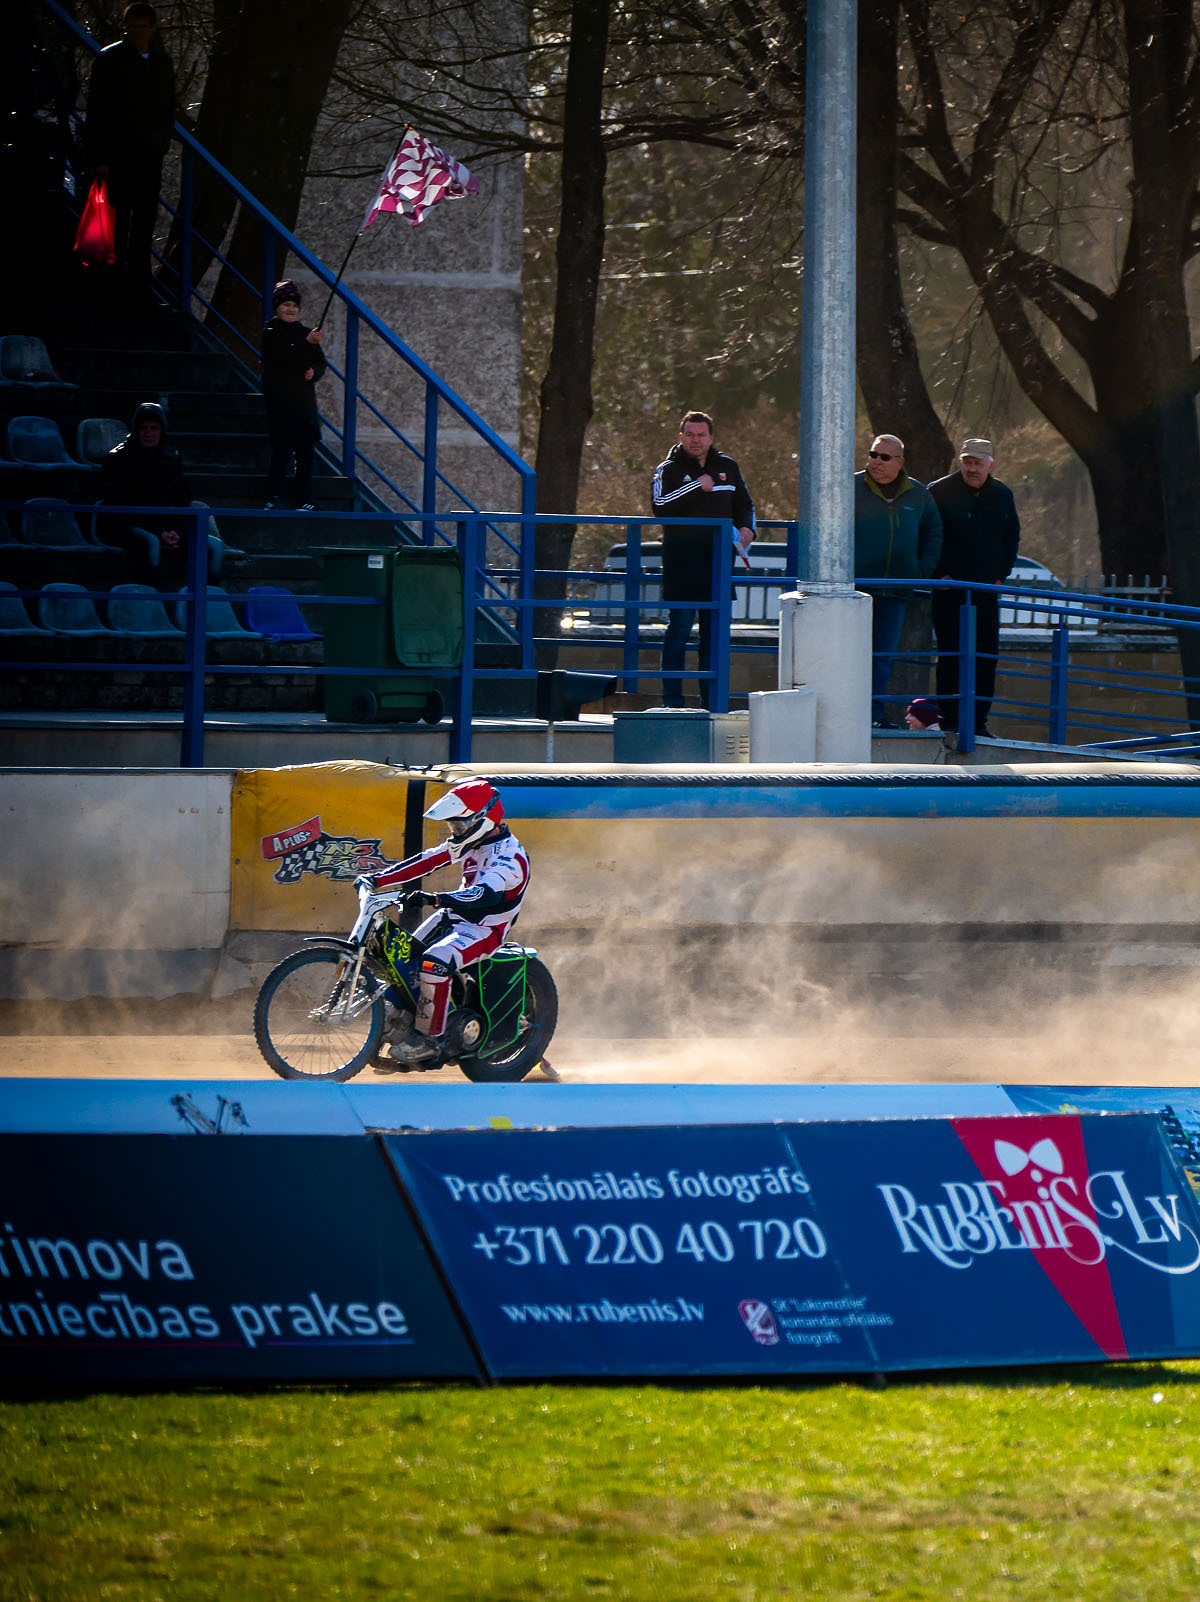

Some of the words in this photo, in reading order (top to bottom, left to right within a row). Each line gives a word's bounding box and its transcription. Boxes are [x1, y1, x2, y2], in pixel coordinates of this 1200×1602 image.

[272, 837, 284, 852] A
[442, 1171, 665, 1202] Profesionālais
[666, 1166, 811, 1203] fotogrāfs
[473, 1224, 571, 1266] +371
[573, 1223, 664, 1265] 220
[675, 1220, 735, 1263] 40
[738, 1216, 828, 1261] 720
[231, 1291, 410, 1349] prakse
[500, 1297, 705, 1323] www.rubenis.lv
